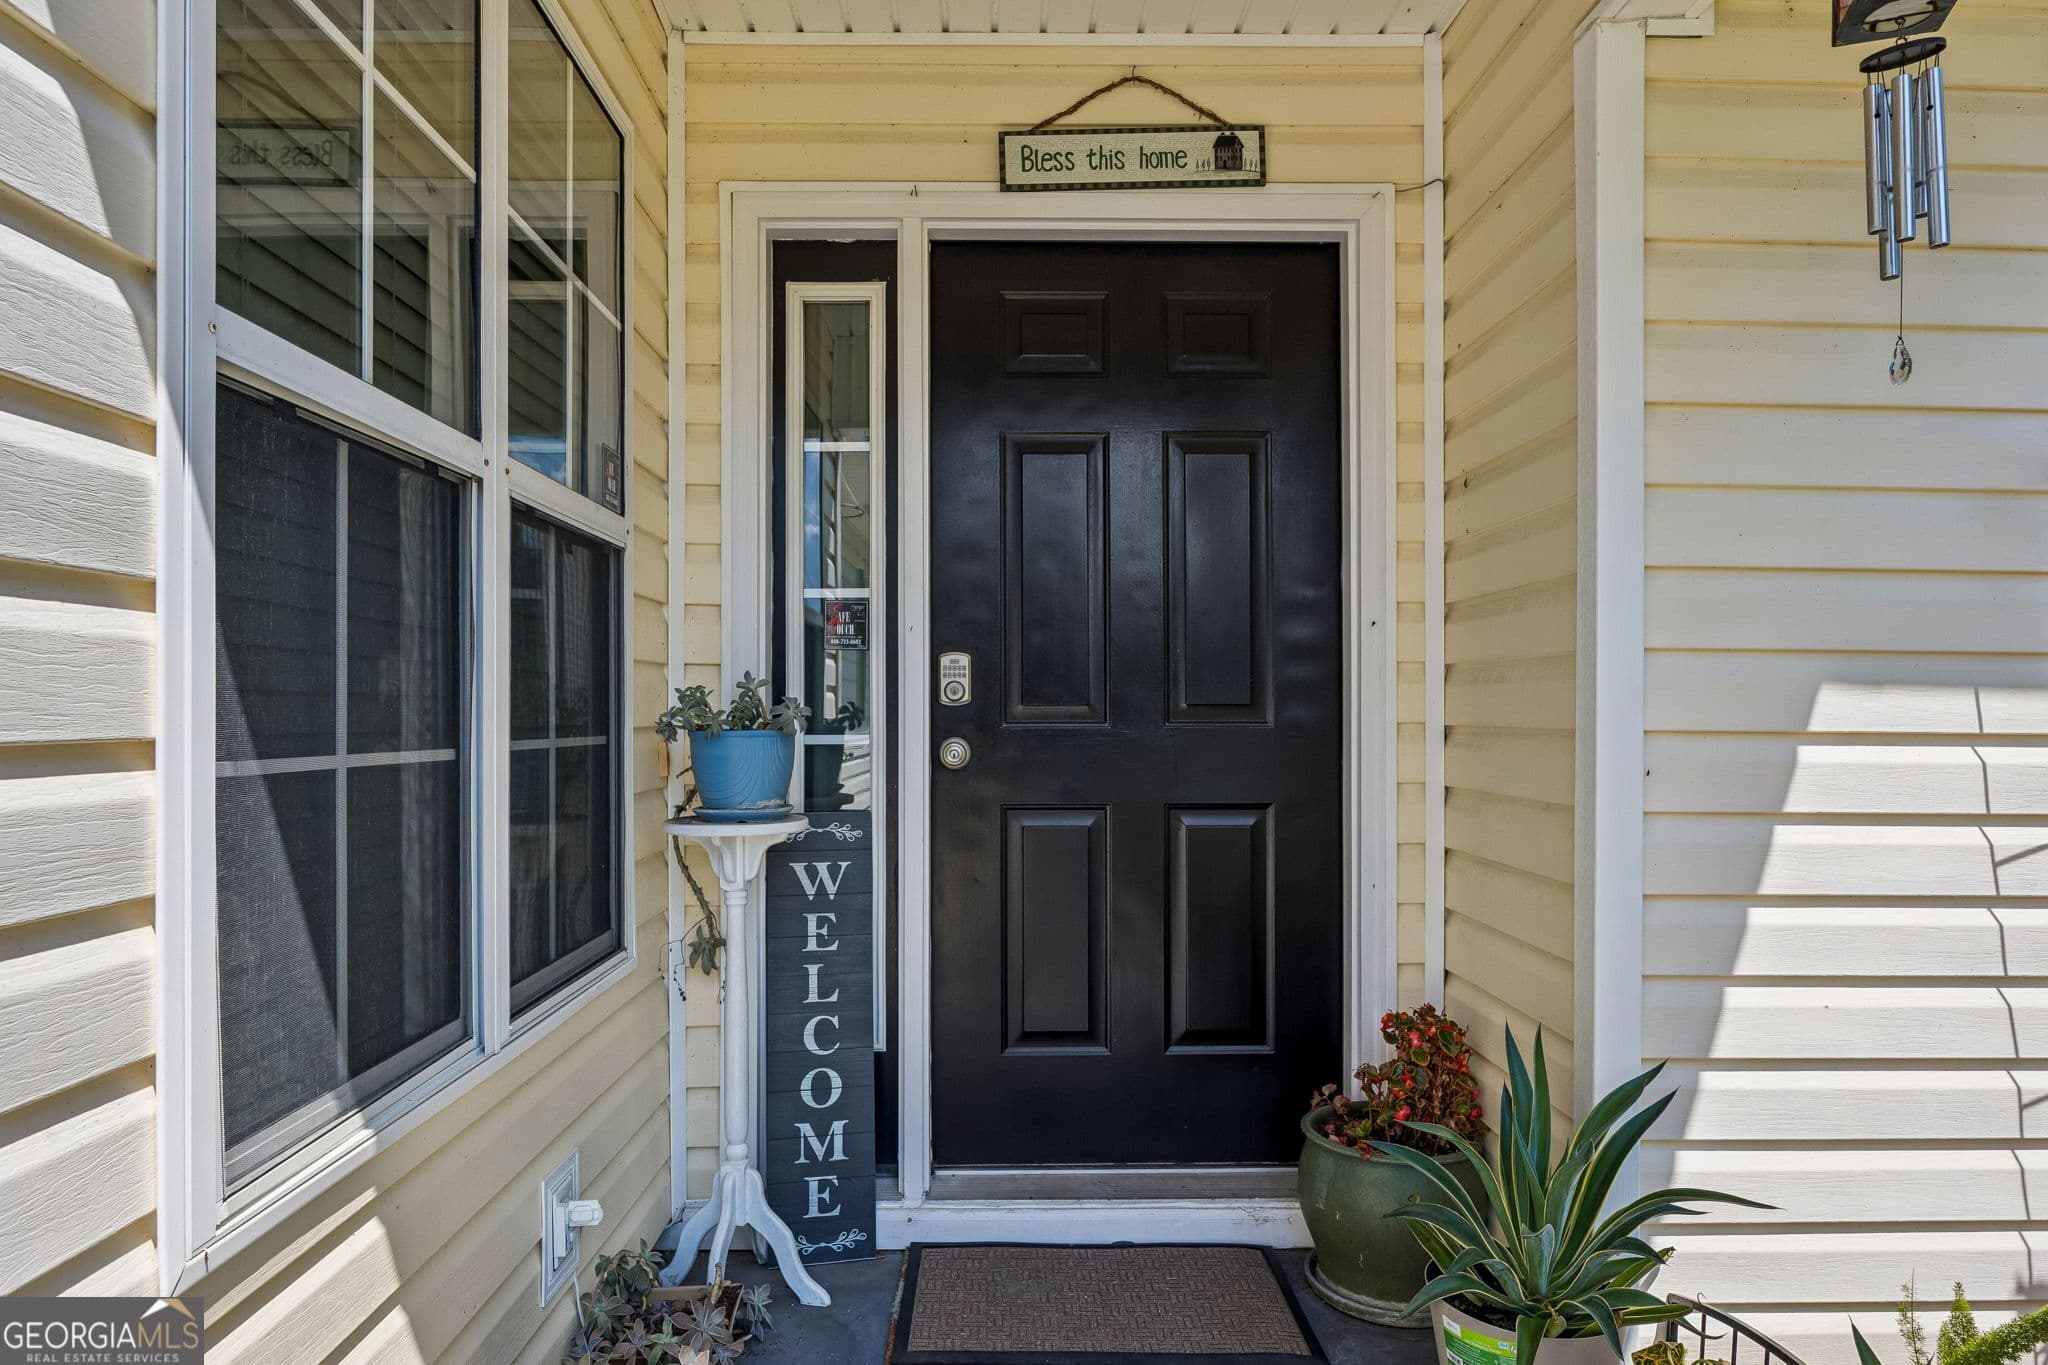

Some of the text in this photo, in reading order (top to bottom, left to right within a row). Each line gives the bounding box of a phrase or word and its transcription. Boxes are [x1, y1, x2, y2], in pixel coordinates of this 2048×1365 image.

[1020, 144, 1188, 173] Bless this home
[788, 861, 852, 1219] WELCOME
